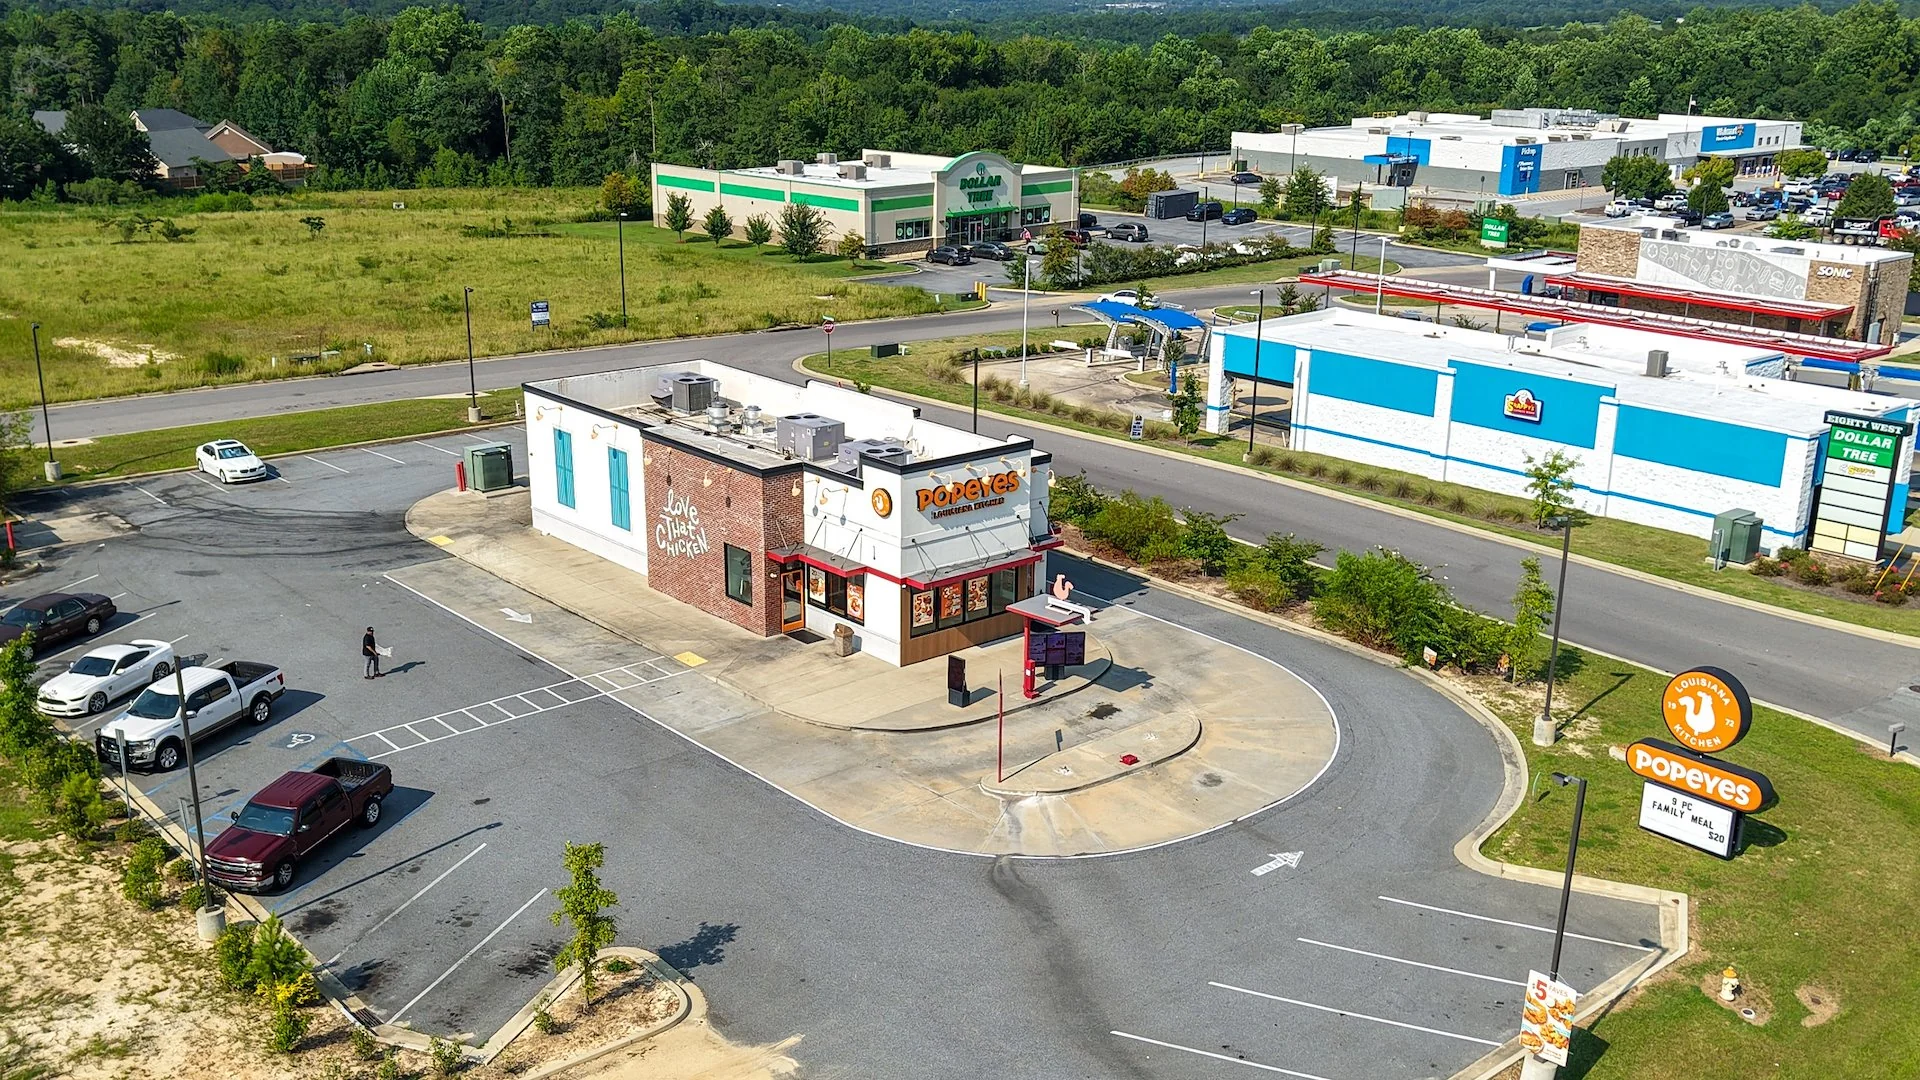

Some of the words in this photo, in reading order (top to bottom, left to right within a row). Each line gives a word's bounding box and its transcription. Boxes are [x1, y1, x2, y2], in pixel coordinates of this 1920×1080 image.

[960, 175, 1002, 190] DOLLAR
[967, 190, 994, 203] TREE
[1484, 223, 1506, 232] DOLLAR
[1817, 265, 1853, 279] SONIC
[1827, 414, 1870, 429] EIGHTY
[1870, 422, 1904, 435] WEST
[1834, 429, 1893, 450] DOLLAR
[1842, 447, 1879, 463] TREE
[1674, 677, 1731, 706] LOUISIANA
[1667, 701, 1677, 710] 19
[1724, 718, 1735, 728] 72
[1673, 723, 1722, 748] KITCHEN
[1671, 797, 1678, 806] 9
[1681, 802, 1693, 812] PC
[1652, 800, 1685, 819] FAMILY
[1690, 814, 1714, 830] MEAL
